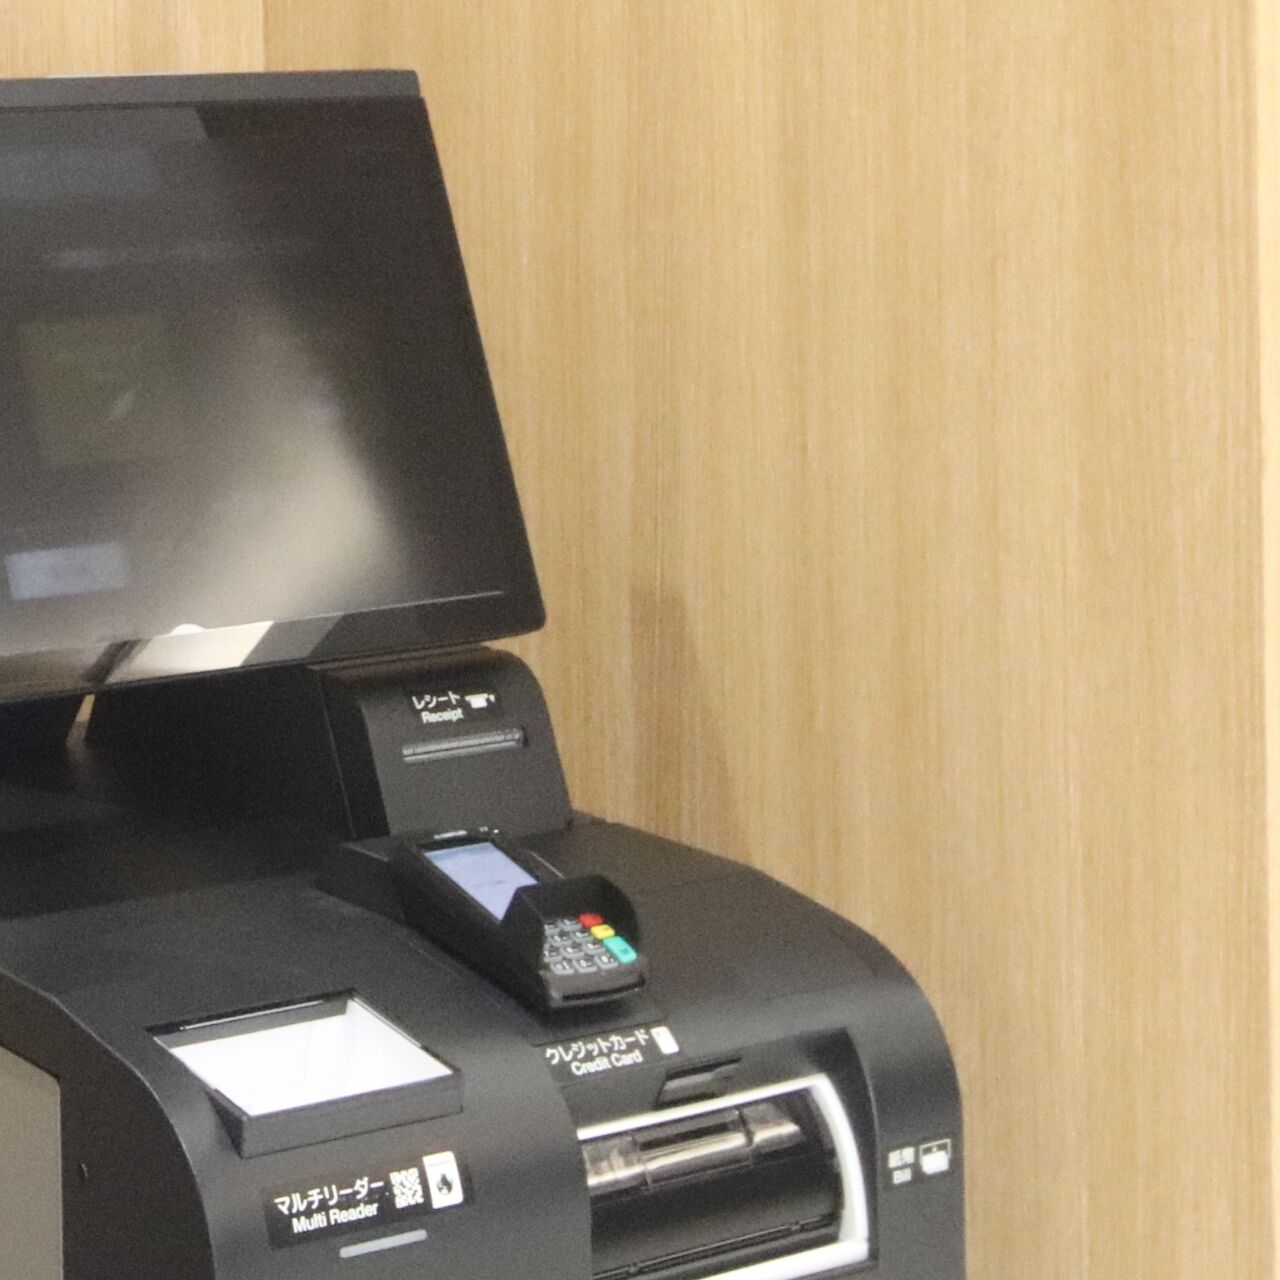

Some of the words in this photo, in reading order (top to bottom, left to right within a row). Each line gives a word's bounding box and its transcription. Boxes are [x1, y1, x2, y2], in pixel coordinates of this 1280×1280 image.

[412, 690, 461, 710] レシート
[545, 1029, 650, 1065] クレジットカード
[571, 1055, 612, 1076] Credit
[610, 1049, 644, 1067] Card
[273, 1176, 385, 1216] マルチリーダー
[291, 1211, 328, 1234] Multi
[329, 1202, 380, 1226] Reader
